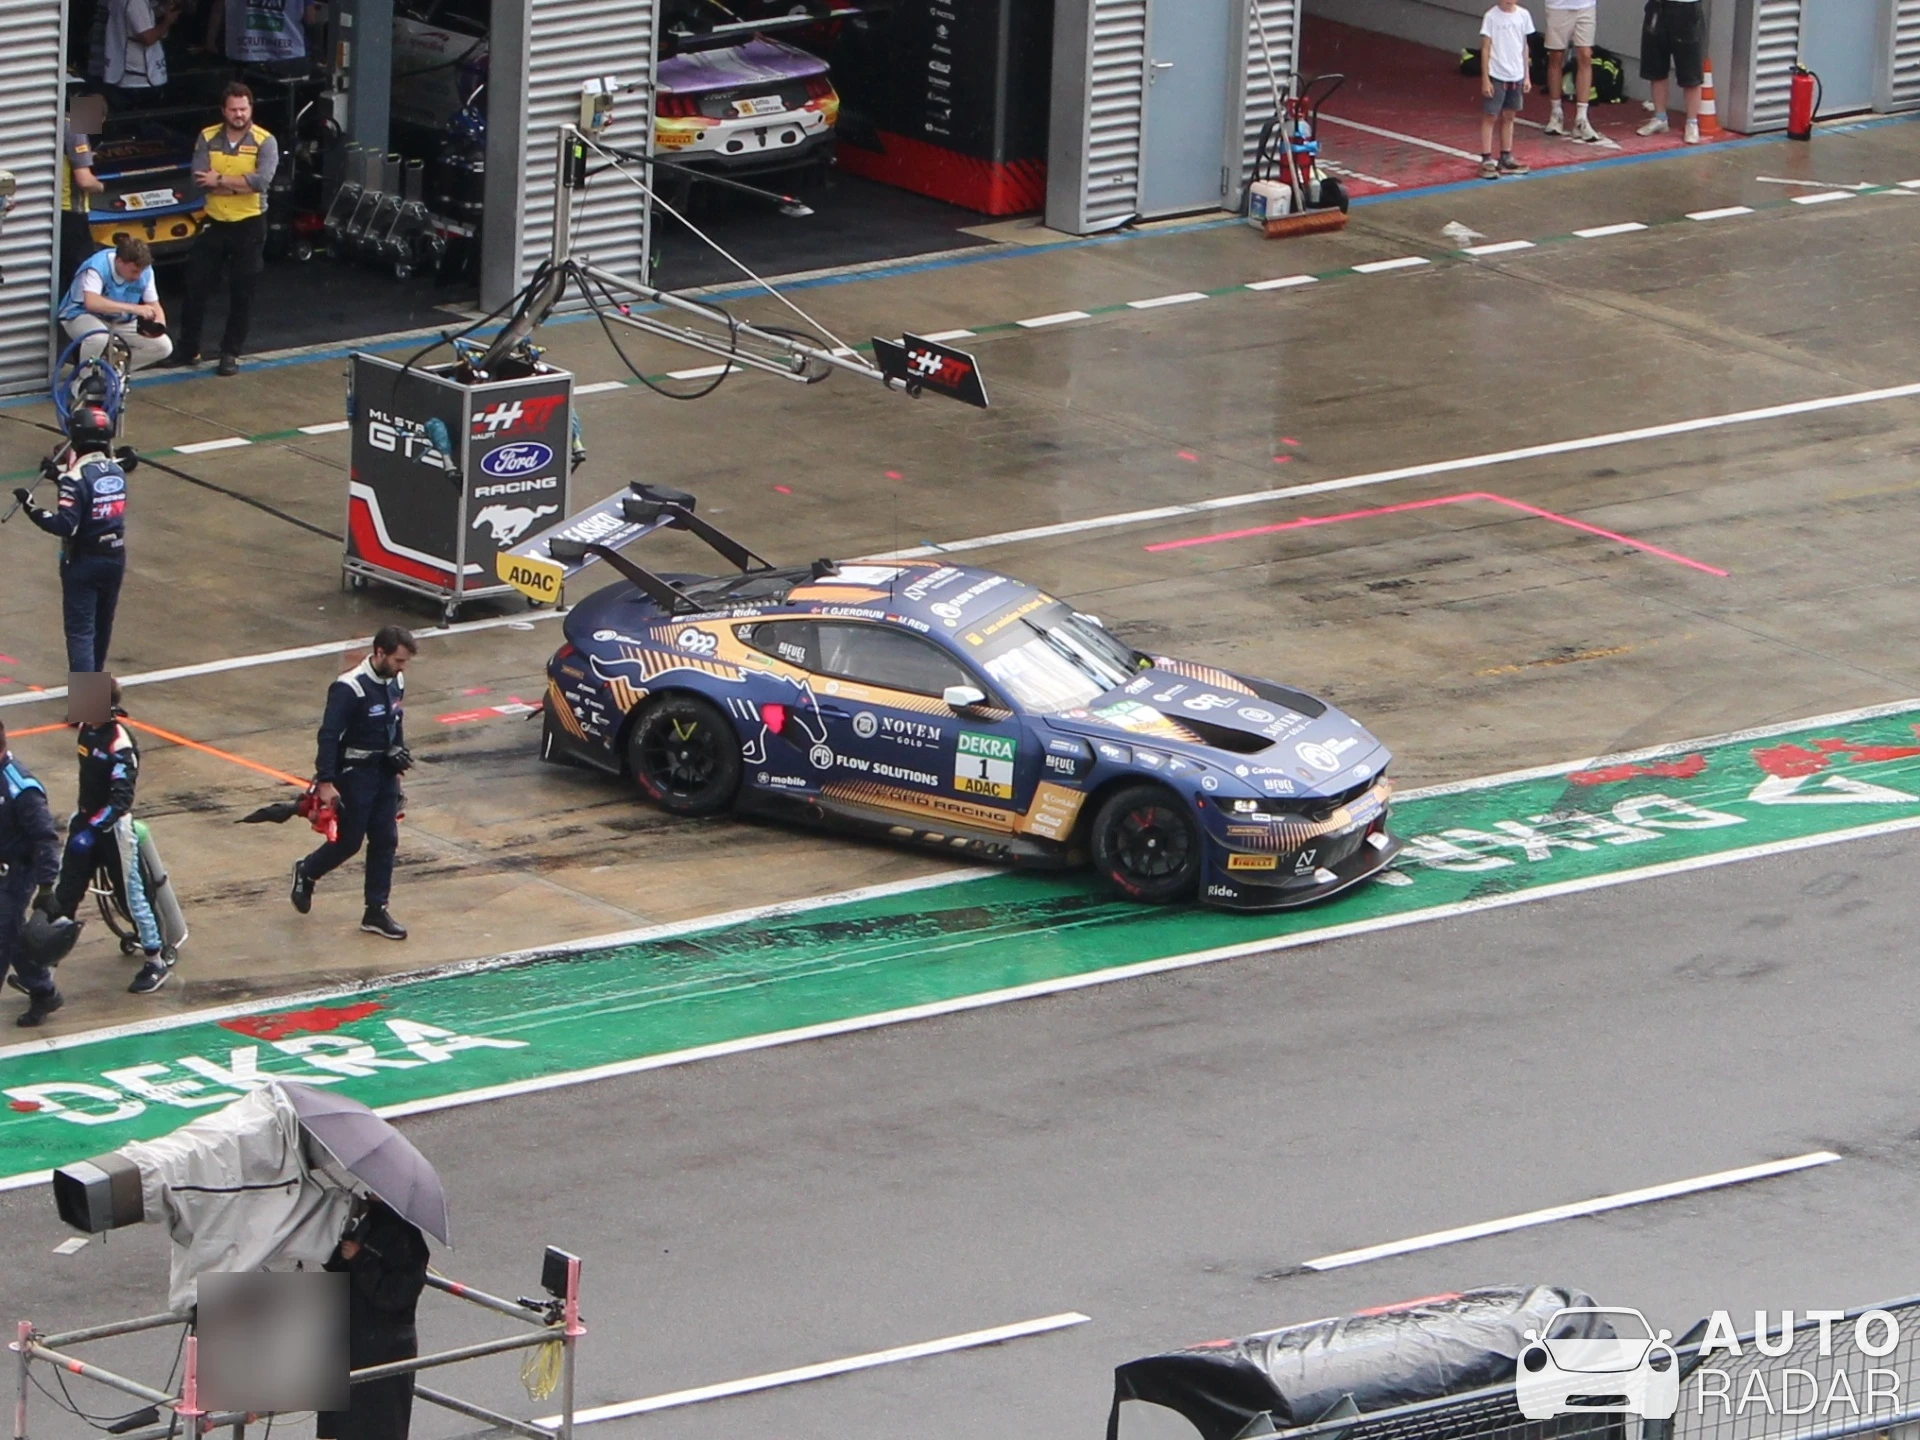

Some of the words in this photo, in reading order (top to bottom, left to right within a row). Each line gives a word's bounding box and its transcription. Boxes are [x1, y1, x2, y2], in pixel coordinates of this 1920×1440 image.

[494, 446, 540, 472] Ford
[474, 476, 558, 498] RACING
[508, 566, 554, 592] ADAC
[880, 715, 942, 741] NOVEM
[896, 736, 923, 748] GOLD
[957, 733, 1014, 760] DEKRA
[836, 754, 871, 772] FLOW
[872, 763, 940, 787] SOLUTIONS
[977, 758, 990, 780] 1
[771, 775, 807, 787] mobile
[965, 778, 1001, 797] ADAC
[933, 801, 1007, 822] RACING
[1233, 857, 1274, 867] PIRELLI
[1207, 884, 1239, 898] Ride.
[2, 1018, 531, 1126] DEKRA
